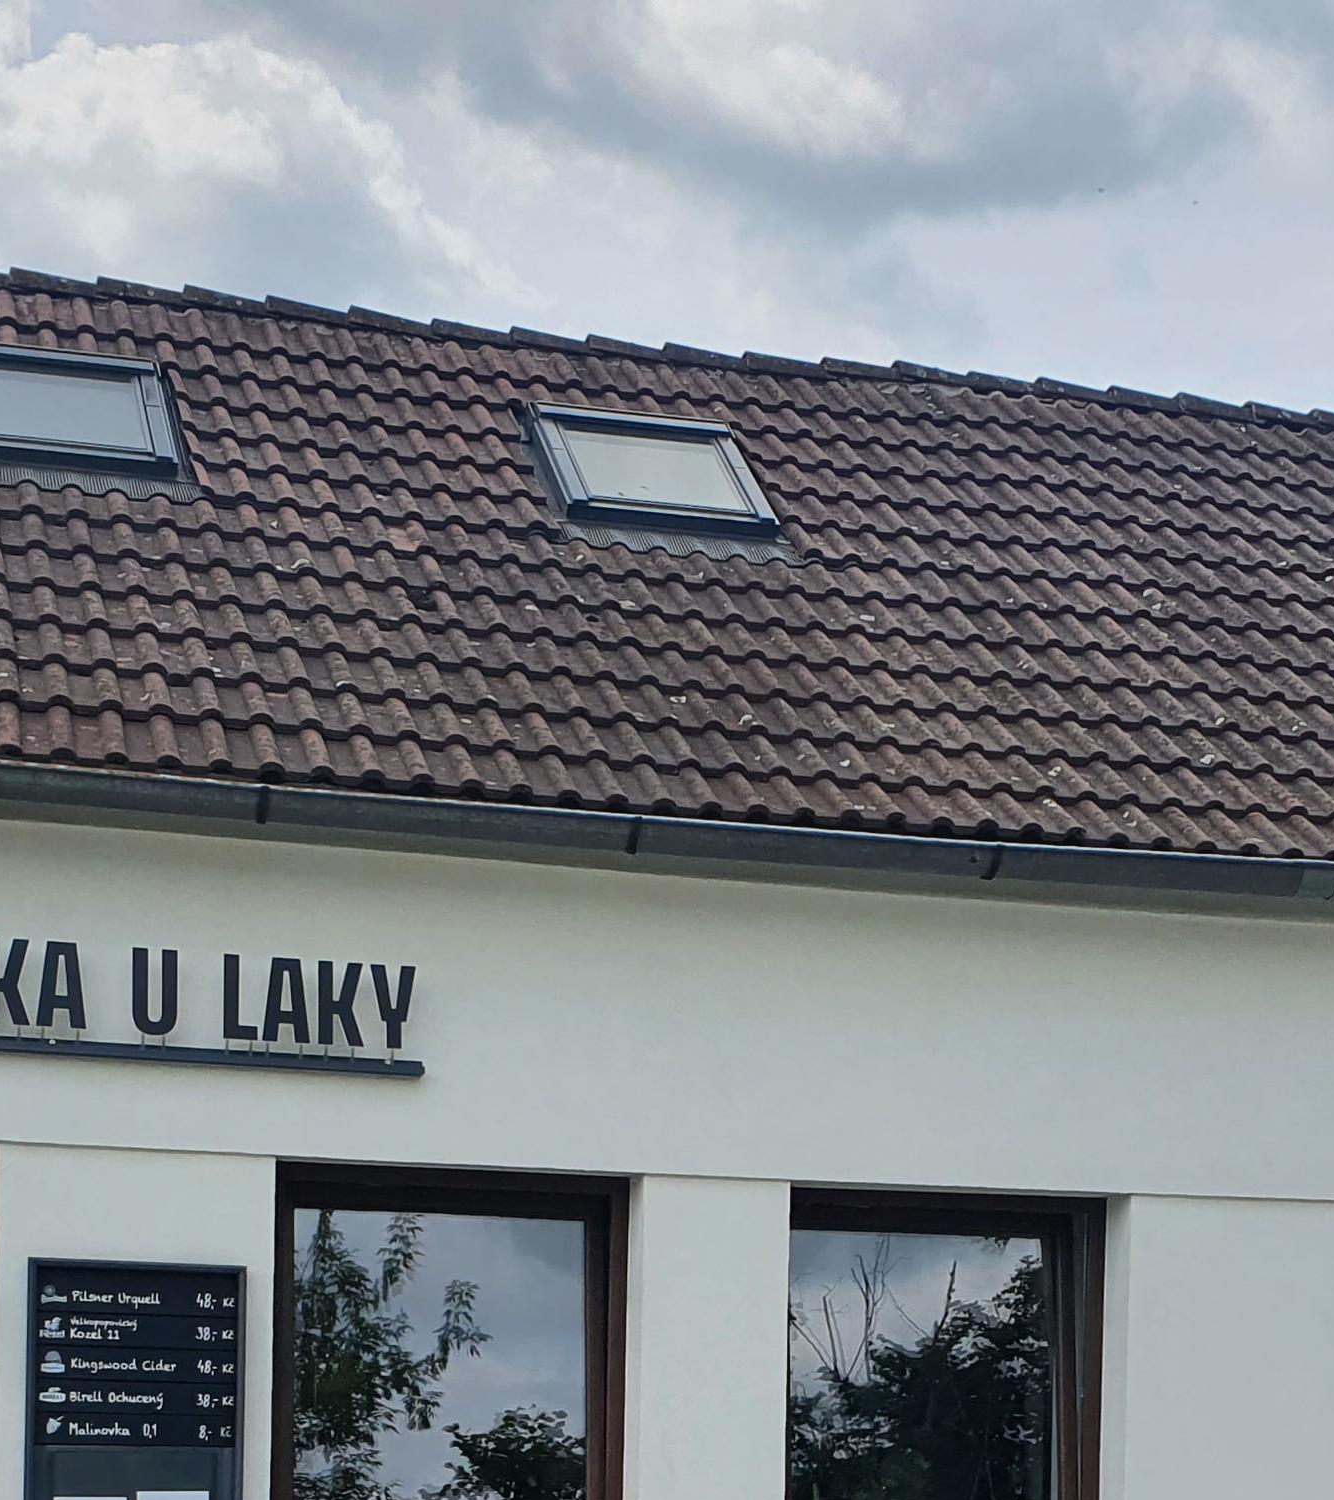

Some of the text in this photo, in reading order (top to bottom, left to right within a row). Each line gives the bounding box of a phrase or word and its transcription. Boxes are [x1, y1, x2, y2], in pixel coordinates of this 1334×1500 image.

[131, 946, 179, 1036] U
[222, 953, 417, 1050] LAKY
[71, 1289, 114, 1303] Pilsner
[117, 1291, 161, 1310] Urquell
[69, 1327, 103, 1340] Kozel
[107, 1329, 121, 1340] 11
[70, 1357, 138, 1374] Kingswood
[141, 1359, 177, 1372] Cider
[69, 1390, 103, 1403] Birell
[108, 1391, 164, 1411] Ochucený
[68, 1421, 131, 1437] Malinovka
[143, 1423, 158, 1439] 0,1
